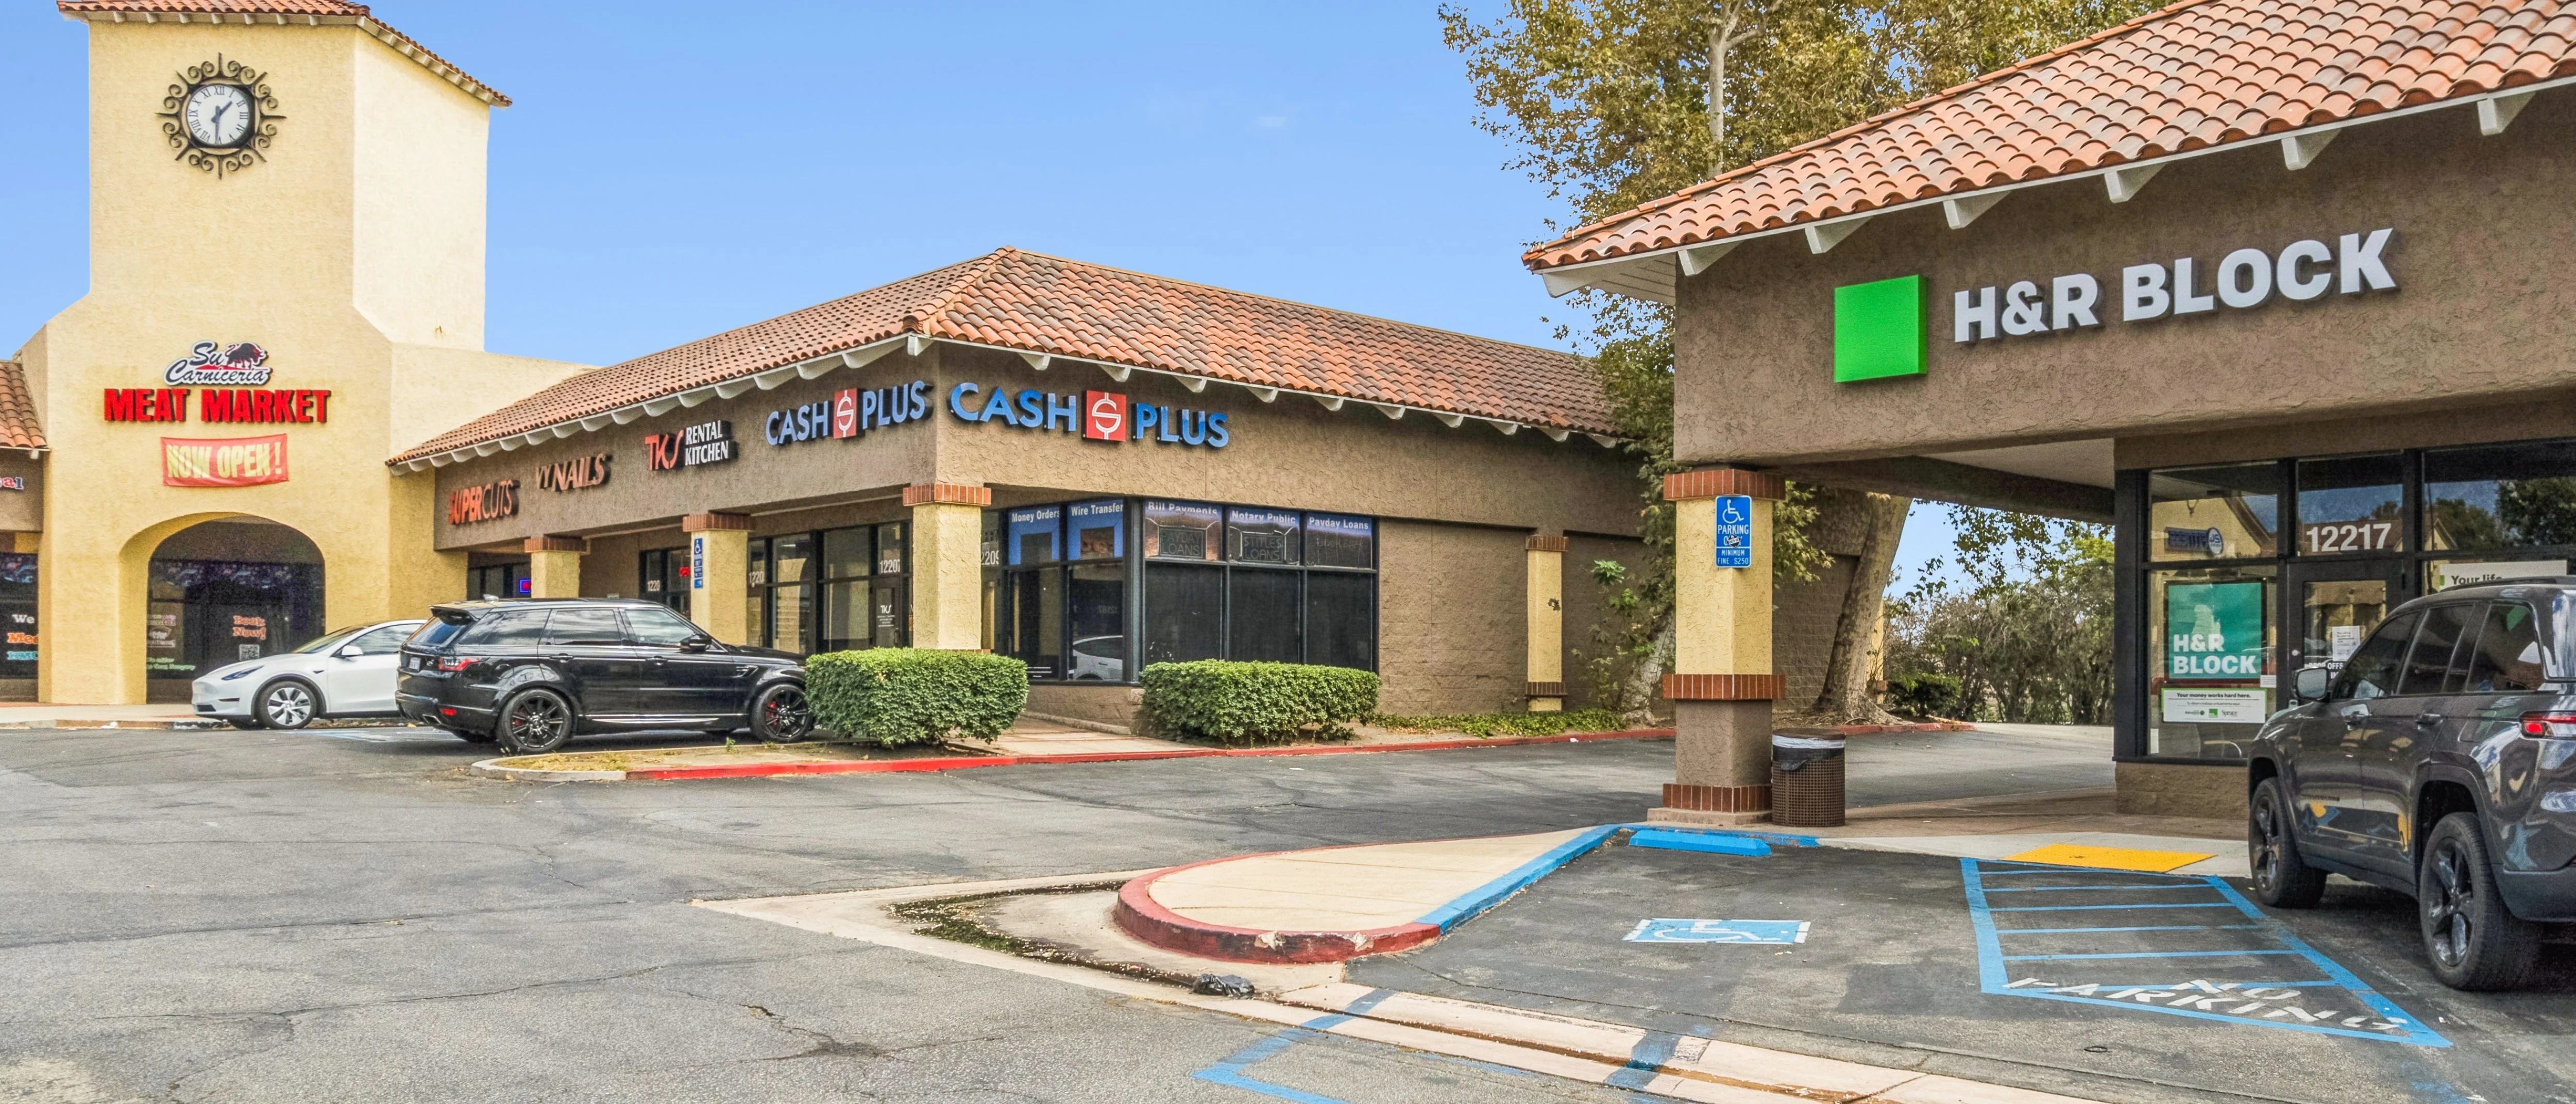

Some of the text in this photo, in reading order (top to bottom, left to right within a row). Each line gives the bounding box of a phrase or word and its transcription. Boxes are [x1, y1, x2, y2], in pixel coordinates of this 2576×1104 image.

[1955, 228, 2396, 343] H&R BLOCK
[189, 342, 225, 366] Su
[104, 388, 330, 423] MEAT MARKET
[766, 400, 829, 445] CASH
[862, 381, 926, 430] PLUS
[951, 382, 1076, 432] CASH
[1135, 403, 1229, 448] PLUS
[685, 420, 722, 445] RENTAL
[166, 444, 211, 479] NOW
[685, 441, 728, 466] KITCHEN
[553, 453, 606, 491] NAILS
[0, 477, 24, 490] al
[449, 480, 513, 524] SUPERCUTS
[1071, 505, 1089, 516] Wire
[1148, 502, 1217, 515] Bill Payments
[1012, 513, 1034, 522] Money
[1232, 511, 1296, 523] Notary Public
[1309, 517, 1368, 530] Payday Loans
[1718, 524, 1749, 534] PARKING
[2307, 523, 2392, 553] 12217
[1163, 543, 1199, 555] LOANS
[1245, 549, 1280, 561] LOANS
[2451, 575, 2480, 584] Your
[12, 614, 35, 624] We
[2174, 634, 2225, 652] H&R
[2174, 655, 2257, 674] BLOCK
[2169, 979, 2301, 999] NO
[2002, 978, 2408, 1030] PARKING
